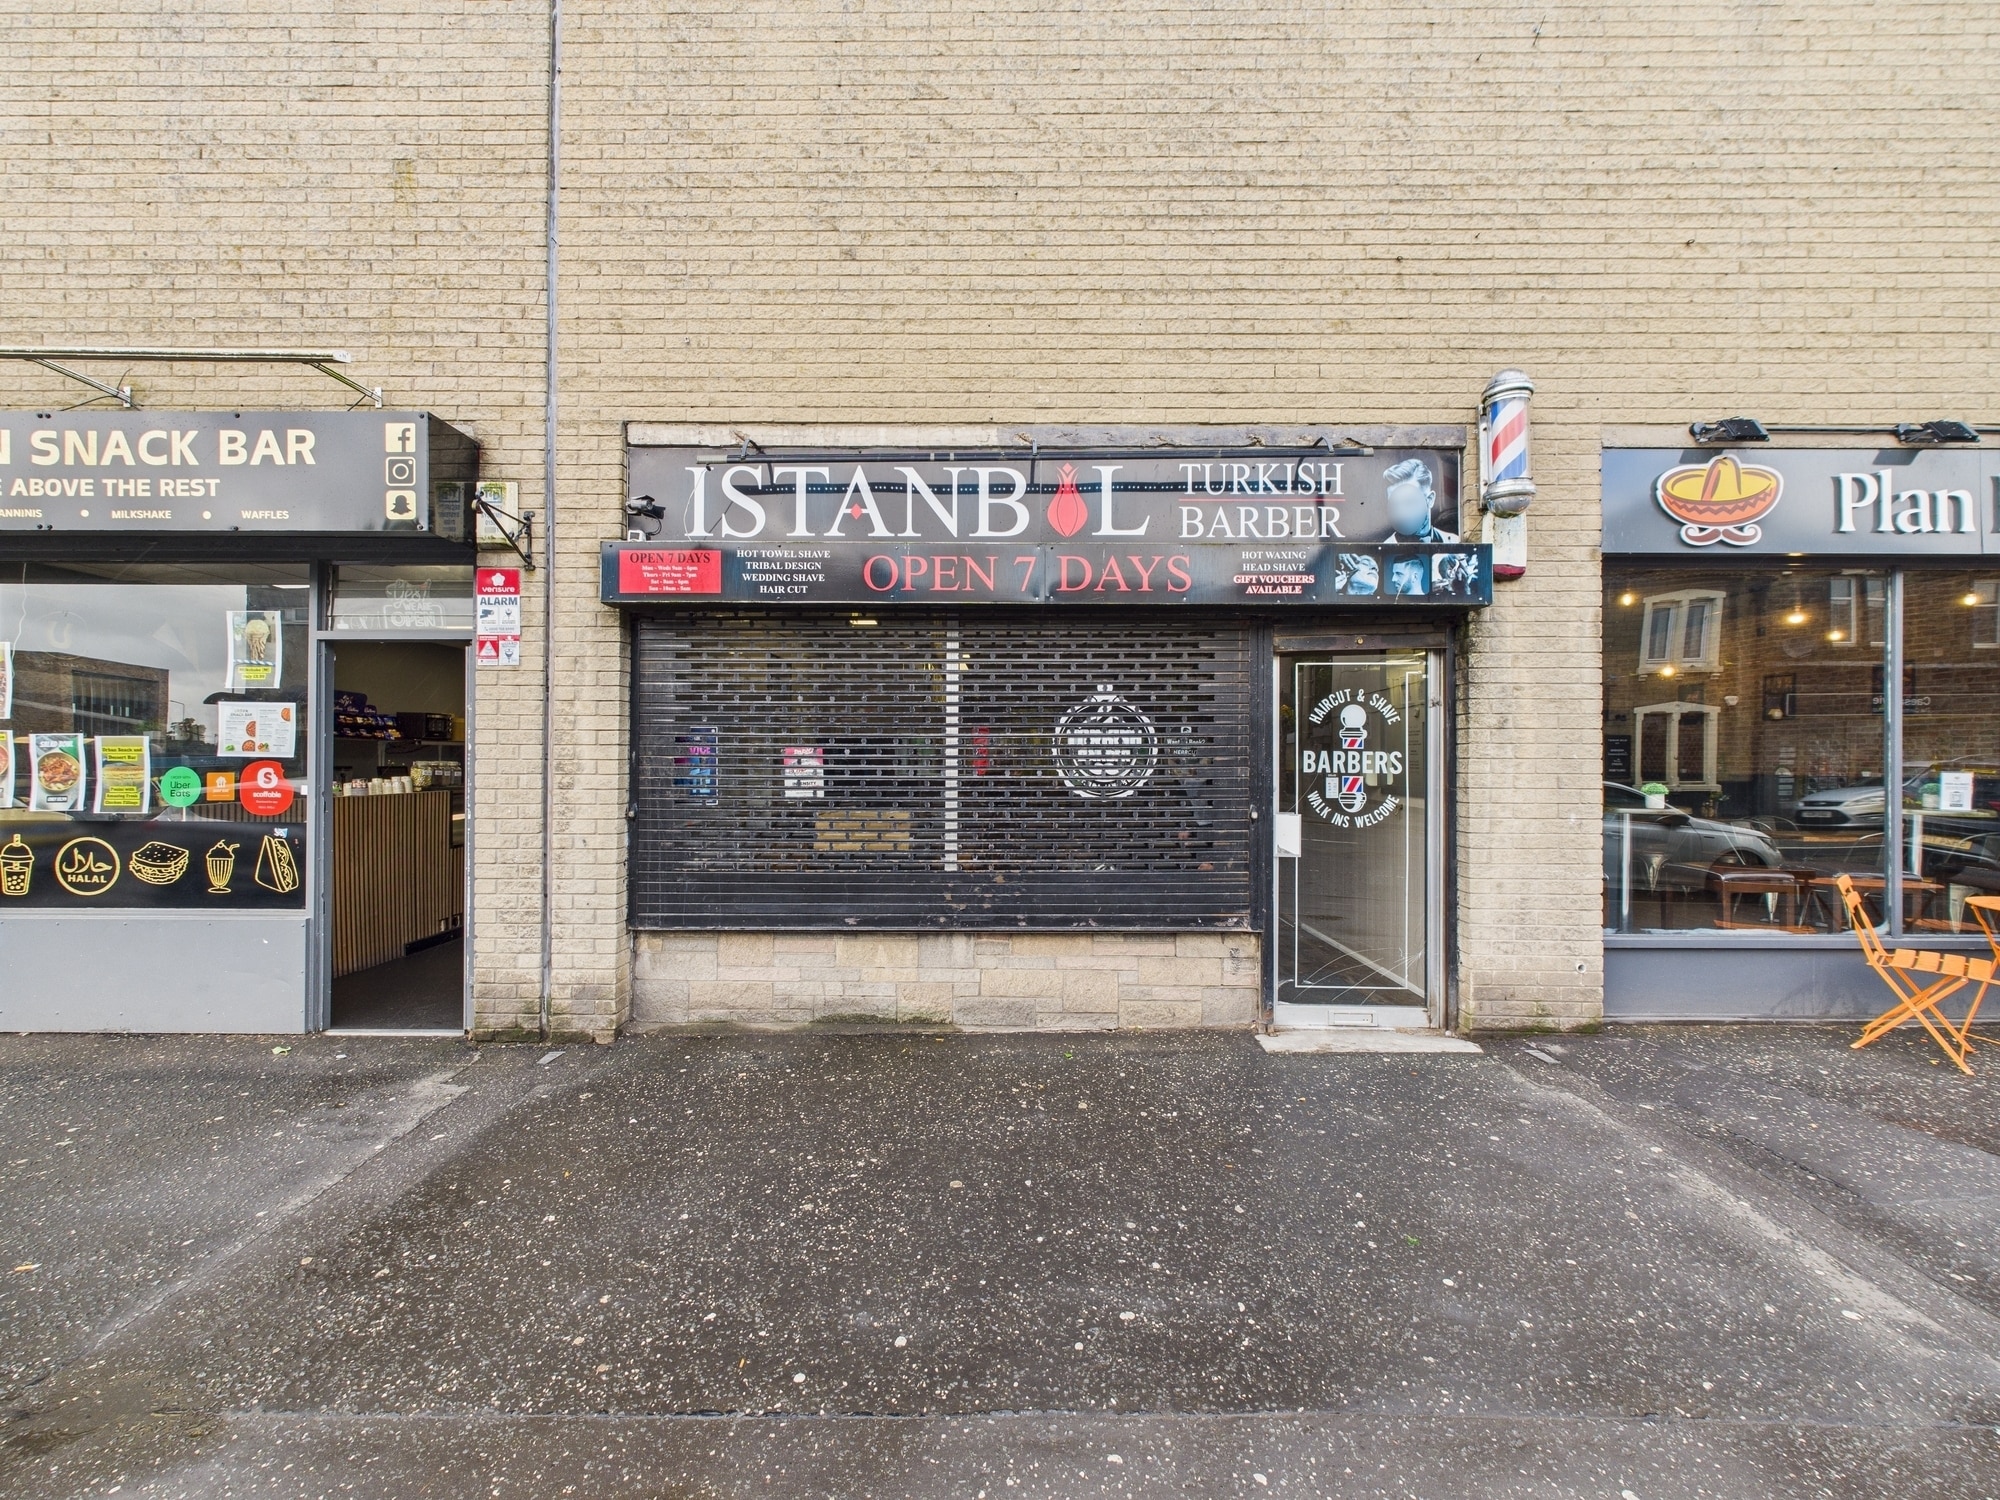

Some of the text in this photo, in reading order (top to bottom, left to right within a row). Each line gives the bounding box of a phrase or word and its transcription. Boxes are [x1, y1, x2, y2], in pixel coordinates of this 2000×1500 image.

[30, 430, 199, 465] SNACK
[219, 429, 316, 465] BAR
[1178, 463, 1345, 495] TURKISH
[10, 478, 94, 497] ABOVE
[102, 478, 151, 497] THE
[160, 478, 221, 497] REST
[1839, 468, 1976, 533] Plan
[111, 509, 172, 519] MILKSHAKE
[241, 509, 289, 520] WAFFLES
[1178, 505, 1346, 538] BARBER
[629, 552, 711, 563] OPEN 7 DAYS
[736, 550, 831, 558] HOT TOWEL SHAVE
[1242, 551, 1307, 560] HOT WAXING
[745, 562, 822, 570] TRIBAL DESIGN
[1243, 563, 1306, 571] HEAD SHAVE
[742, 573, 825, 582] WEDDING SHAVE
[863, 554, 1192, 593] OPEN 7 DAYS
[1233, 575, 1315, 584] GIFT VOUCHERS
[760, 585, 808, 594] HAIR CUT
[1245, 585, 1303, 594] AVAILABLE
[480, 597, 518, 605] ALARM
[391, 611, 436, 627] OPEN
[1309, 689, 1401, 725] HAIRCUT & SHAVE
[1303, 750, 1403, 775] BARBERS
[170, 781, 191, 789] Uber
[1307, 791, 1400, 829] WALK INS WELCOME
[62, 847, 113, 873] حلال
[67, 874, 107, 883] HALAL
